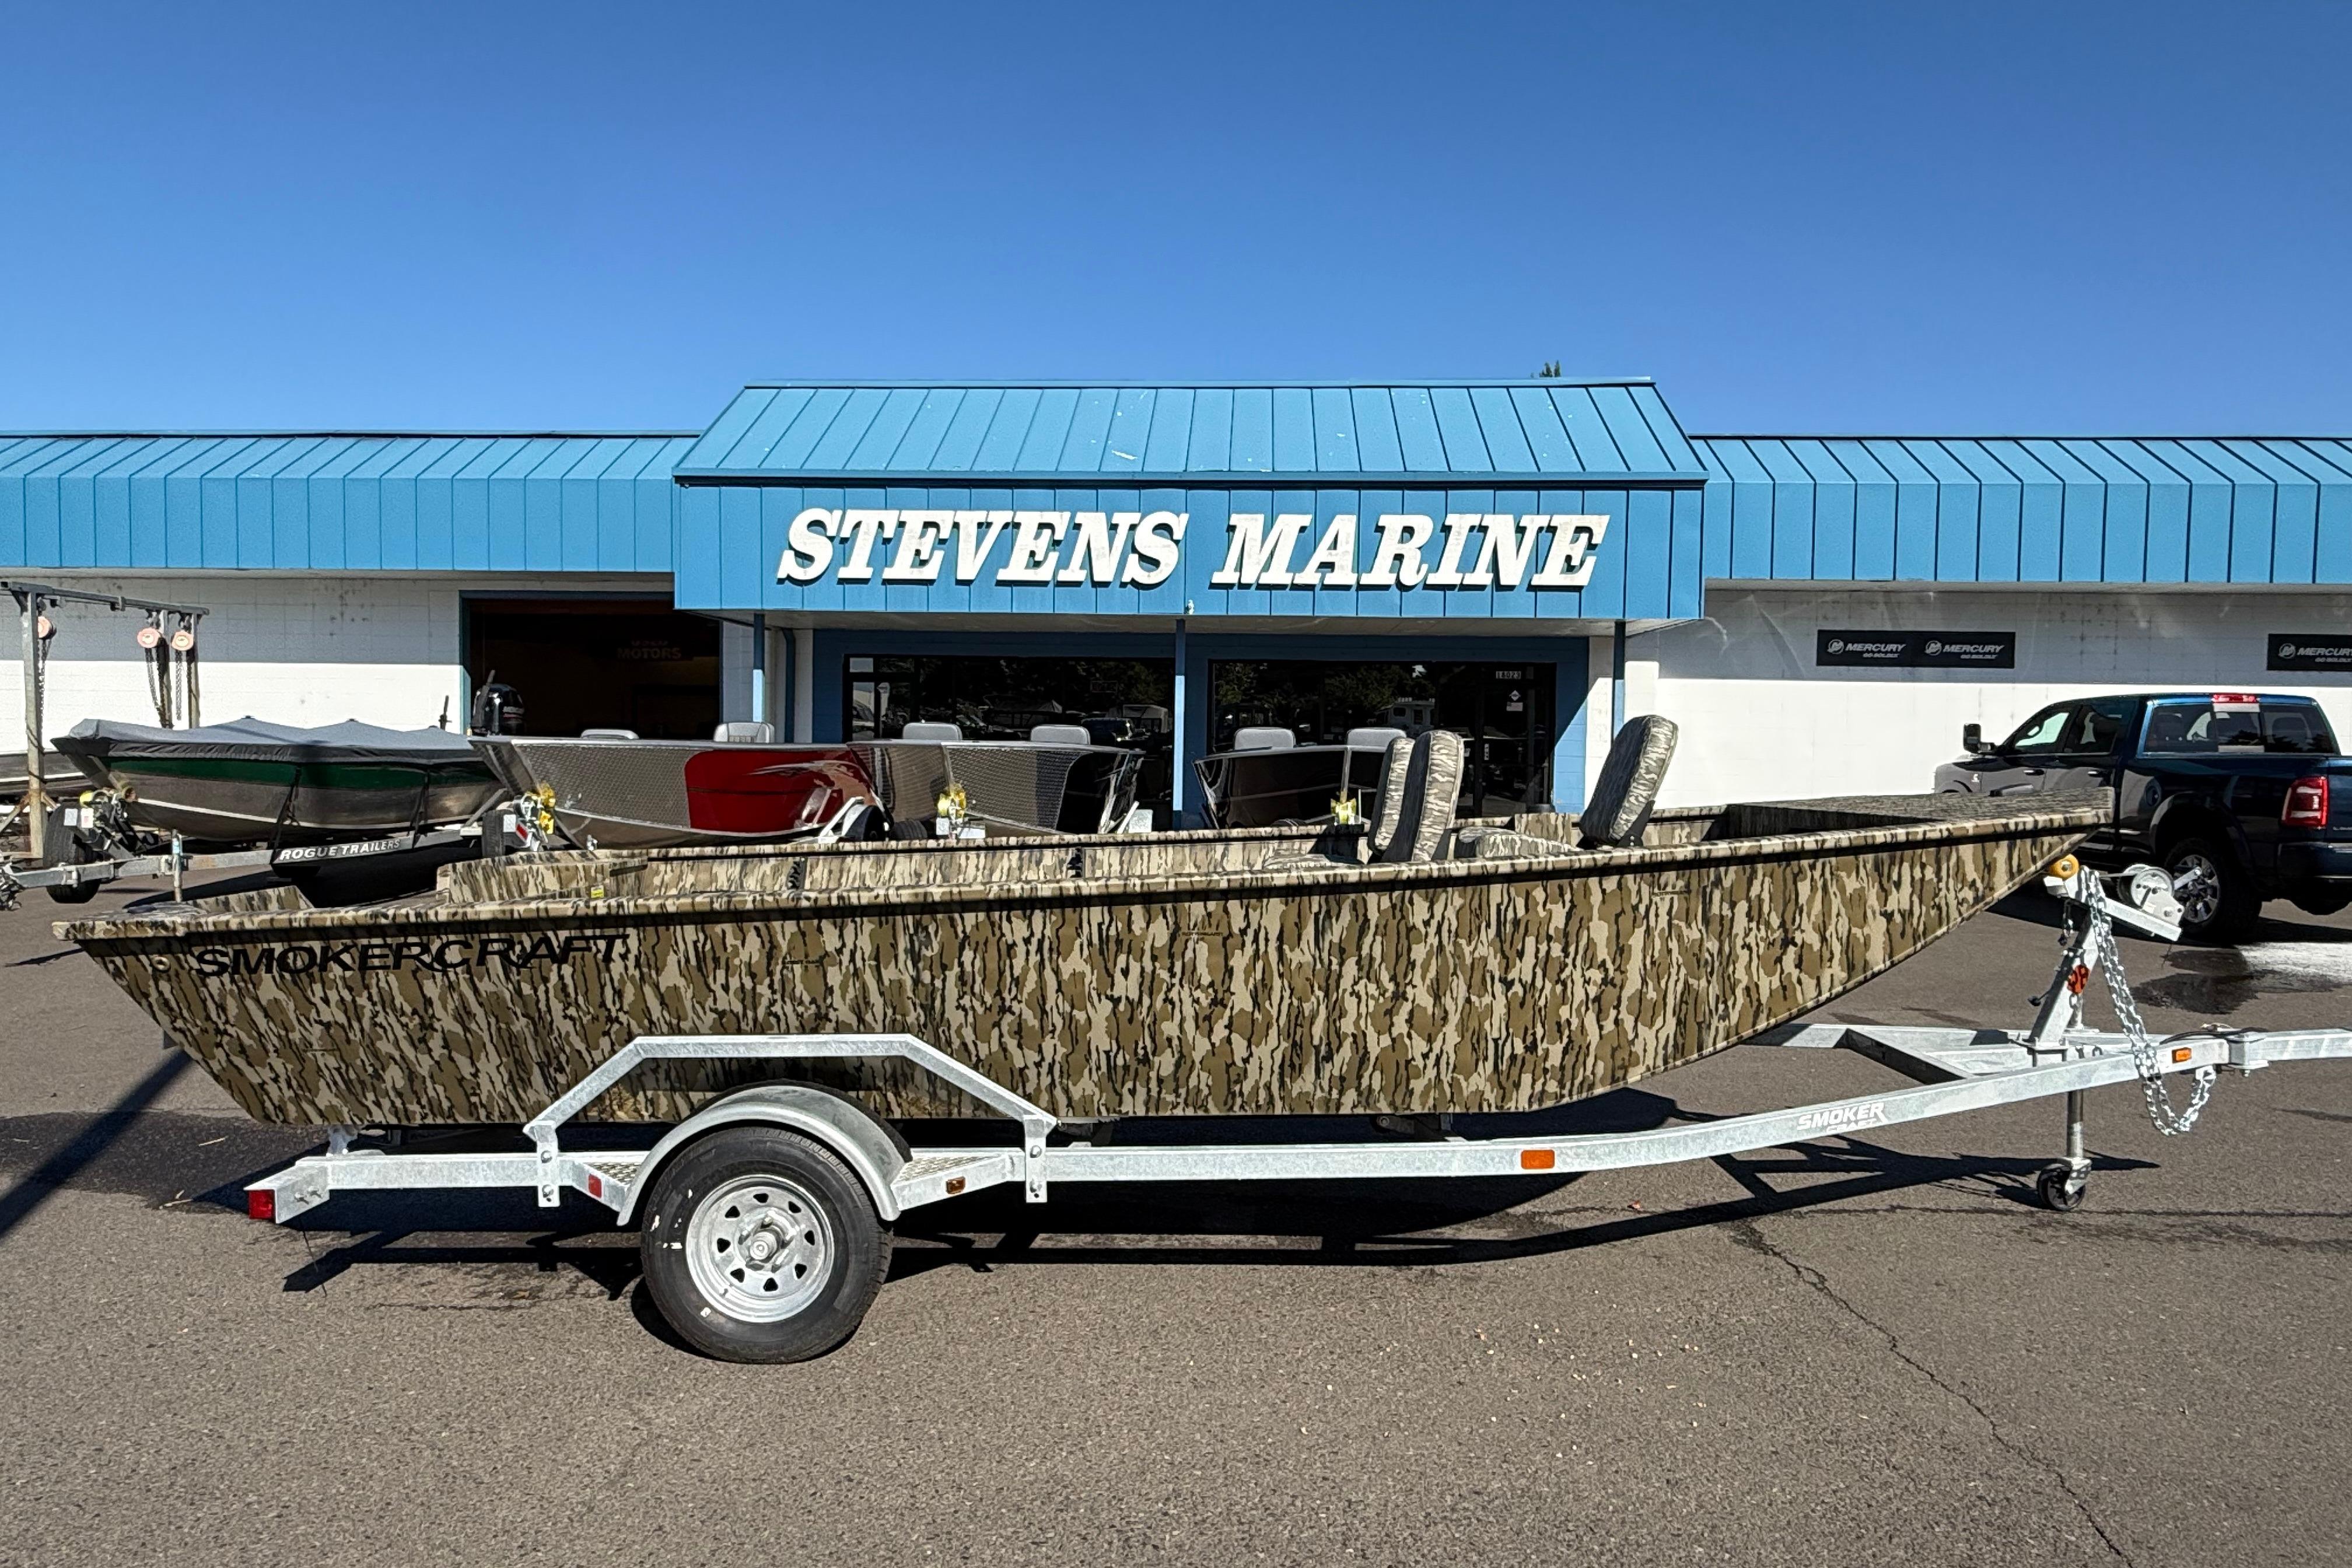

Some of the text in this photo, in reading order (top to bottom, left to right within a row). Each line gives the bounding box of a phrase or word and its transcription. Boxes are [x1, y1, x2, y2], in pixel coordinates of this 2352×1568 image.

[776, 508, 1611, 586] STEVENS MARINE
[617, 648, 682, 659] MOTORS
[1845, 643, 1906, 652] MERCURY
[1943, 644, 2005, 653] MERCURY
[2297, 648, 2352, 656] MERCUR
[279, 839, 401, 860] ROGUE TRAILERS
[194, 934, 630, 976] SMOKERCRAFT
[1797, 1102, 1888, 1130] SMOKER
